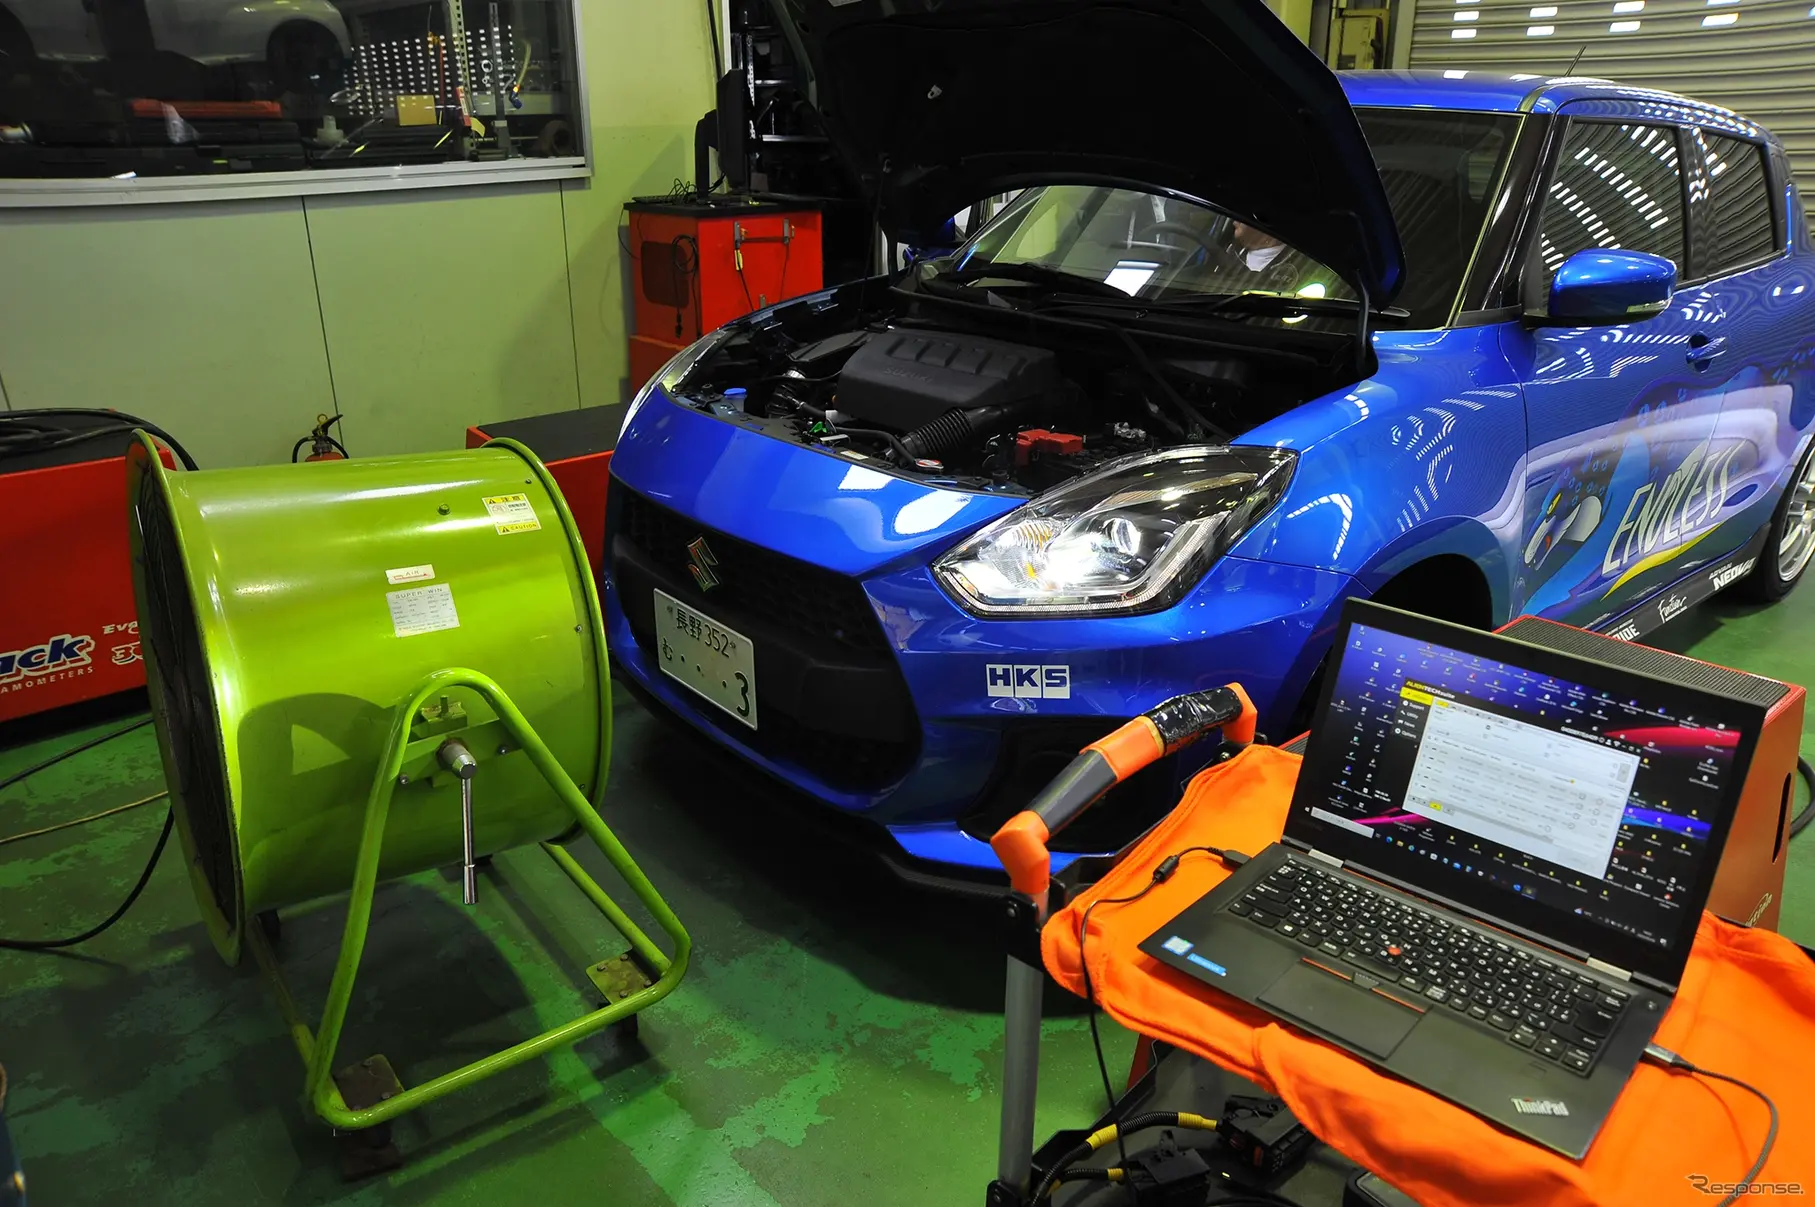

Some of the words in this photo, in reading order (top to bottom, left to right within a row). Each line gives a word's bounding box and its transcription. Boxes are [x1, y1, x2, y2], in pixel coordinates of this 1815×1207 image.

[395, 590, 423, 600] SUPER
[987, 665, 1069, 692] HKS
[1510, 1097, 1569, 1117] ThinkPad
